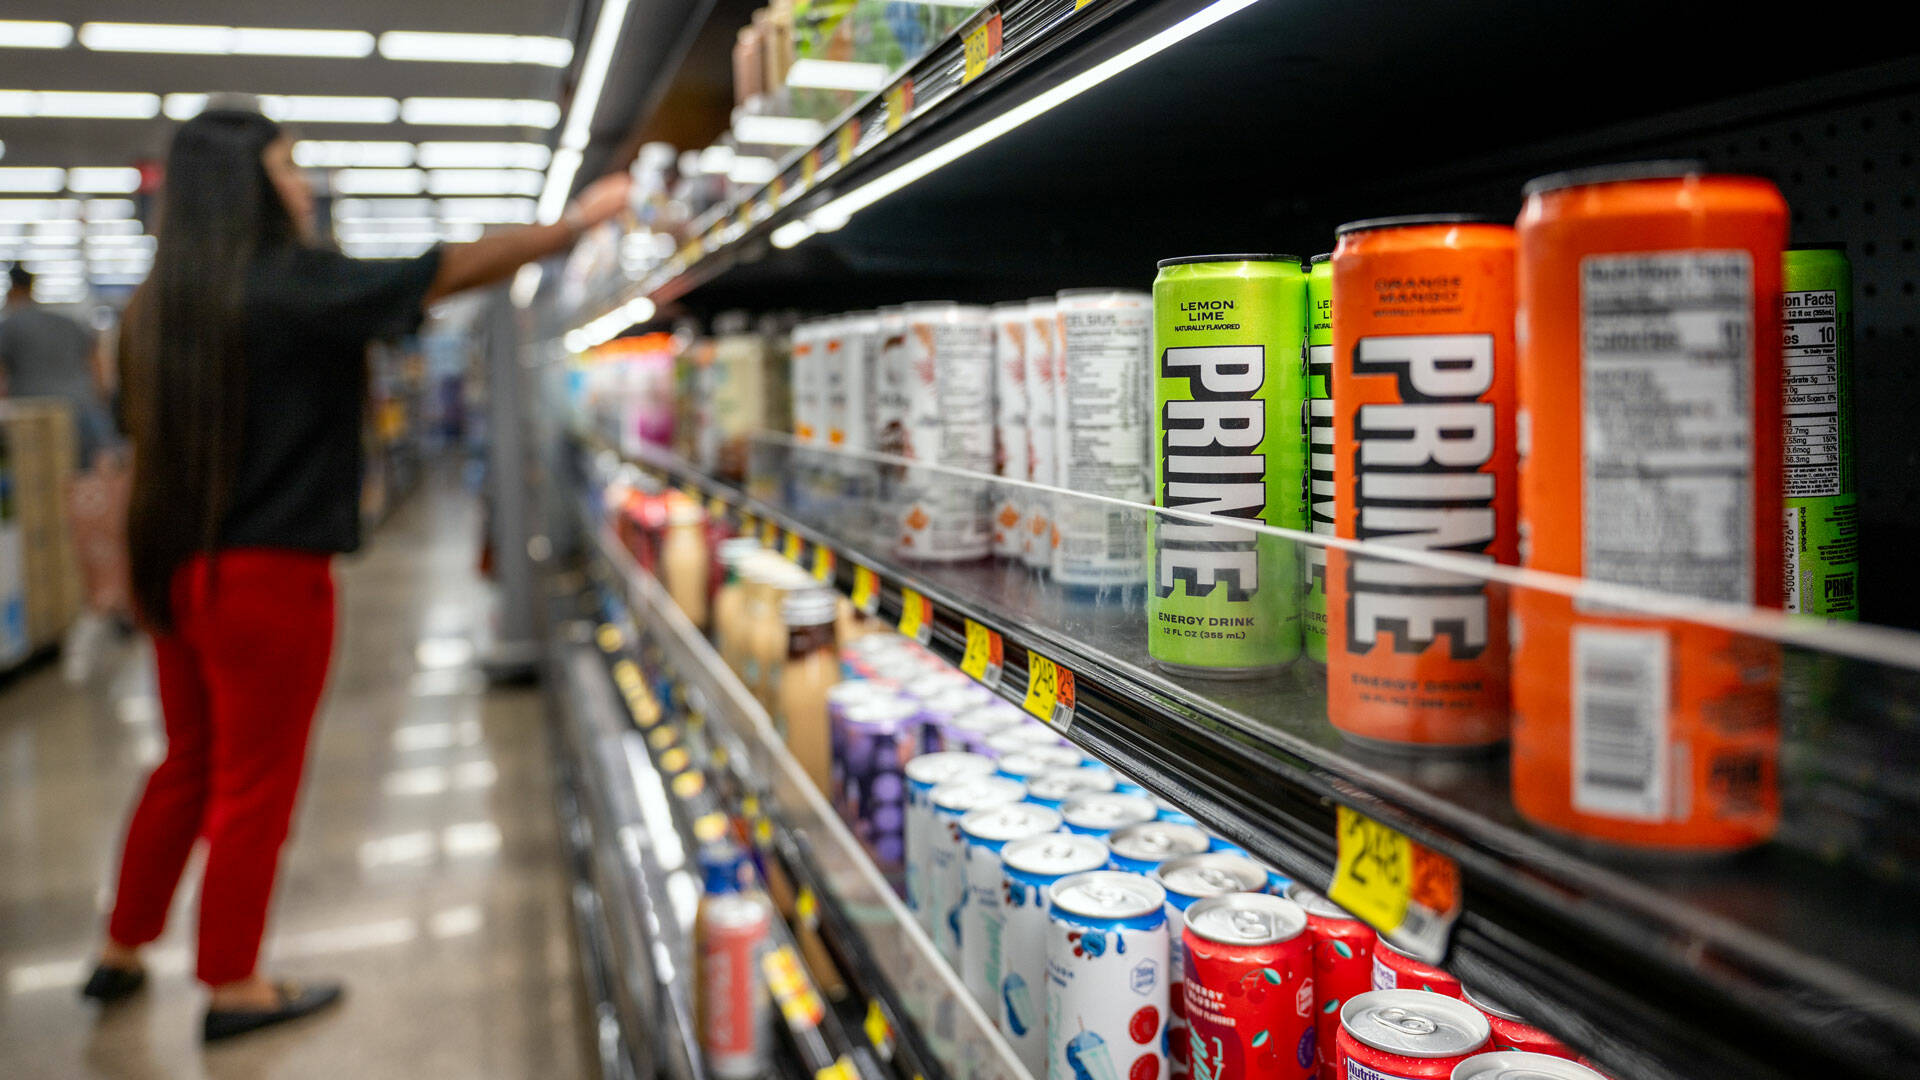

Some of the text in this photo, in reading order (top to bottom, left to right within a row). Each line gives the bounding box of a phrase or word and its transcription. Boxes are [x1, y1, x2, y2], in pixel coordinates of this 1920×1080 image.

[1180, 300, 1234, 311] LEMON
[1804, 293, 1834, 306] Facts
[1188, 311, 1224, 321] LIME
[1175, 324, 1205, 332] NATURALLY
[1819, 326, 1835, 343] 10
[1155, 345, 1265, 601] PRIME
[1347, 333, 1495, 659] PRIME
[1158, 612, 1255, 627] ENERGY DRINK
[1164, 627, 1171, 635] 12
[1184, 630, 1198, 638] OZ
[1199, 631, 1224, 640] (355
[1226, 631, 1246, 640] mL)
[1349, 1061, 1385, 1080] Nutriti
